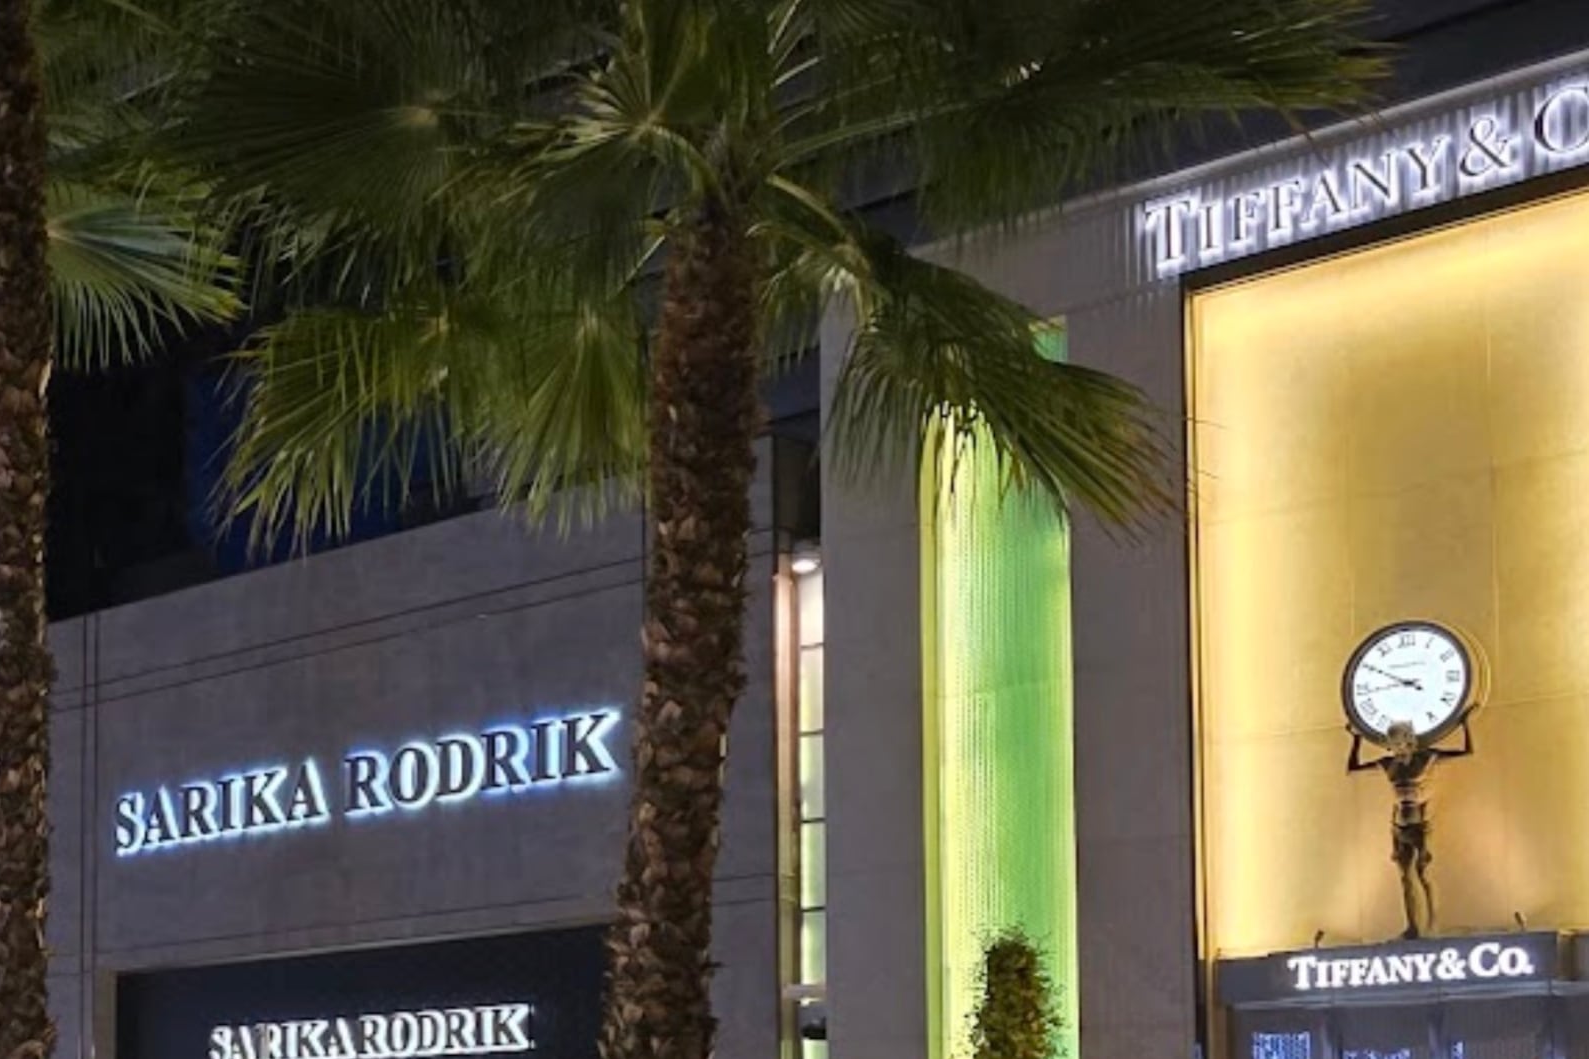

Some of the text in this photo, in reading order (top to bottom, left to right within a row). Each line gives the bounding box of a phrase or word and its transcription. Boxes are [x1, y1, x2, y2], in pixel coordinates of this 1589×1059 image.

[1143, 138, 1445, 266] TIFFANY
[115, 708, 620, 857] SARIKA RODRIK
[1287, 953, 1436, 990] TIFFANY
[357, 1003, 529, 1059] RODRIK
